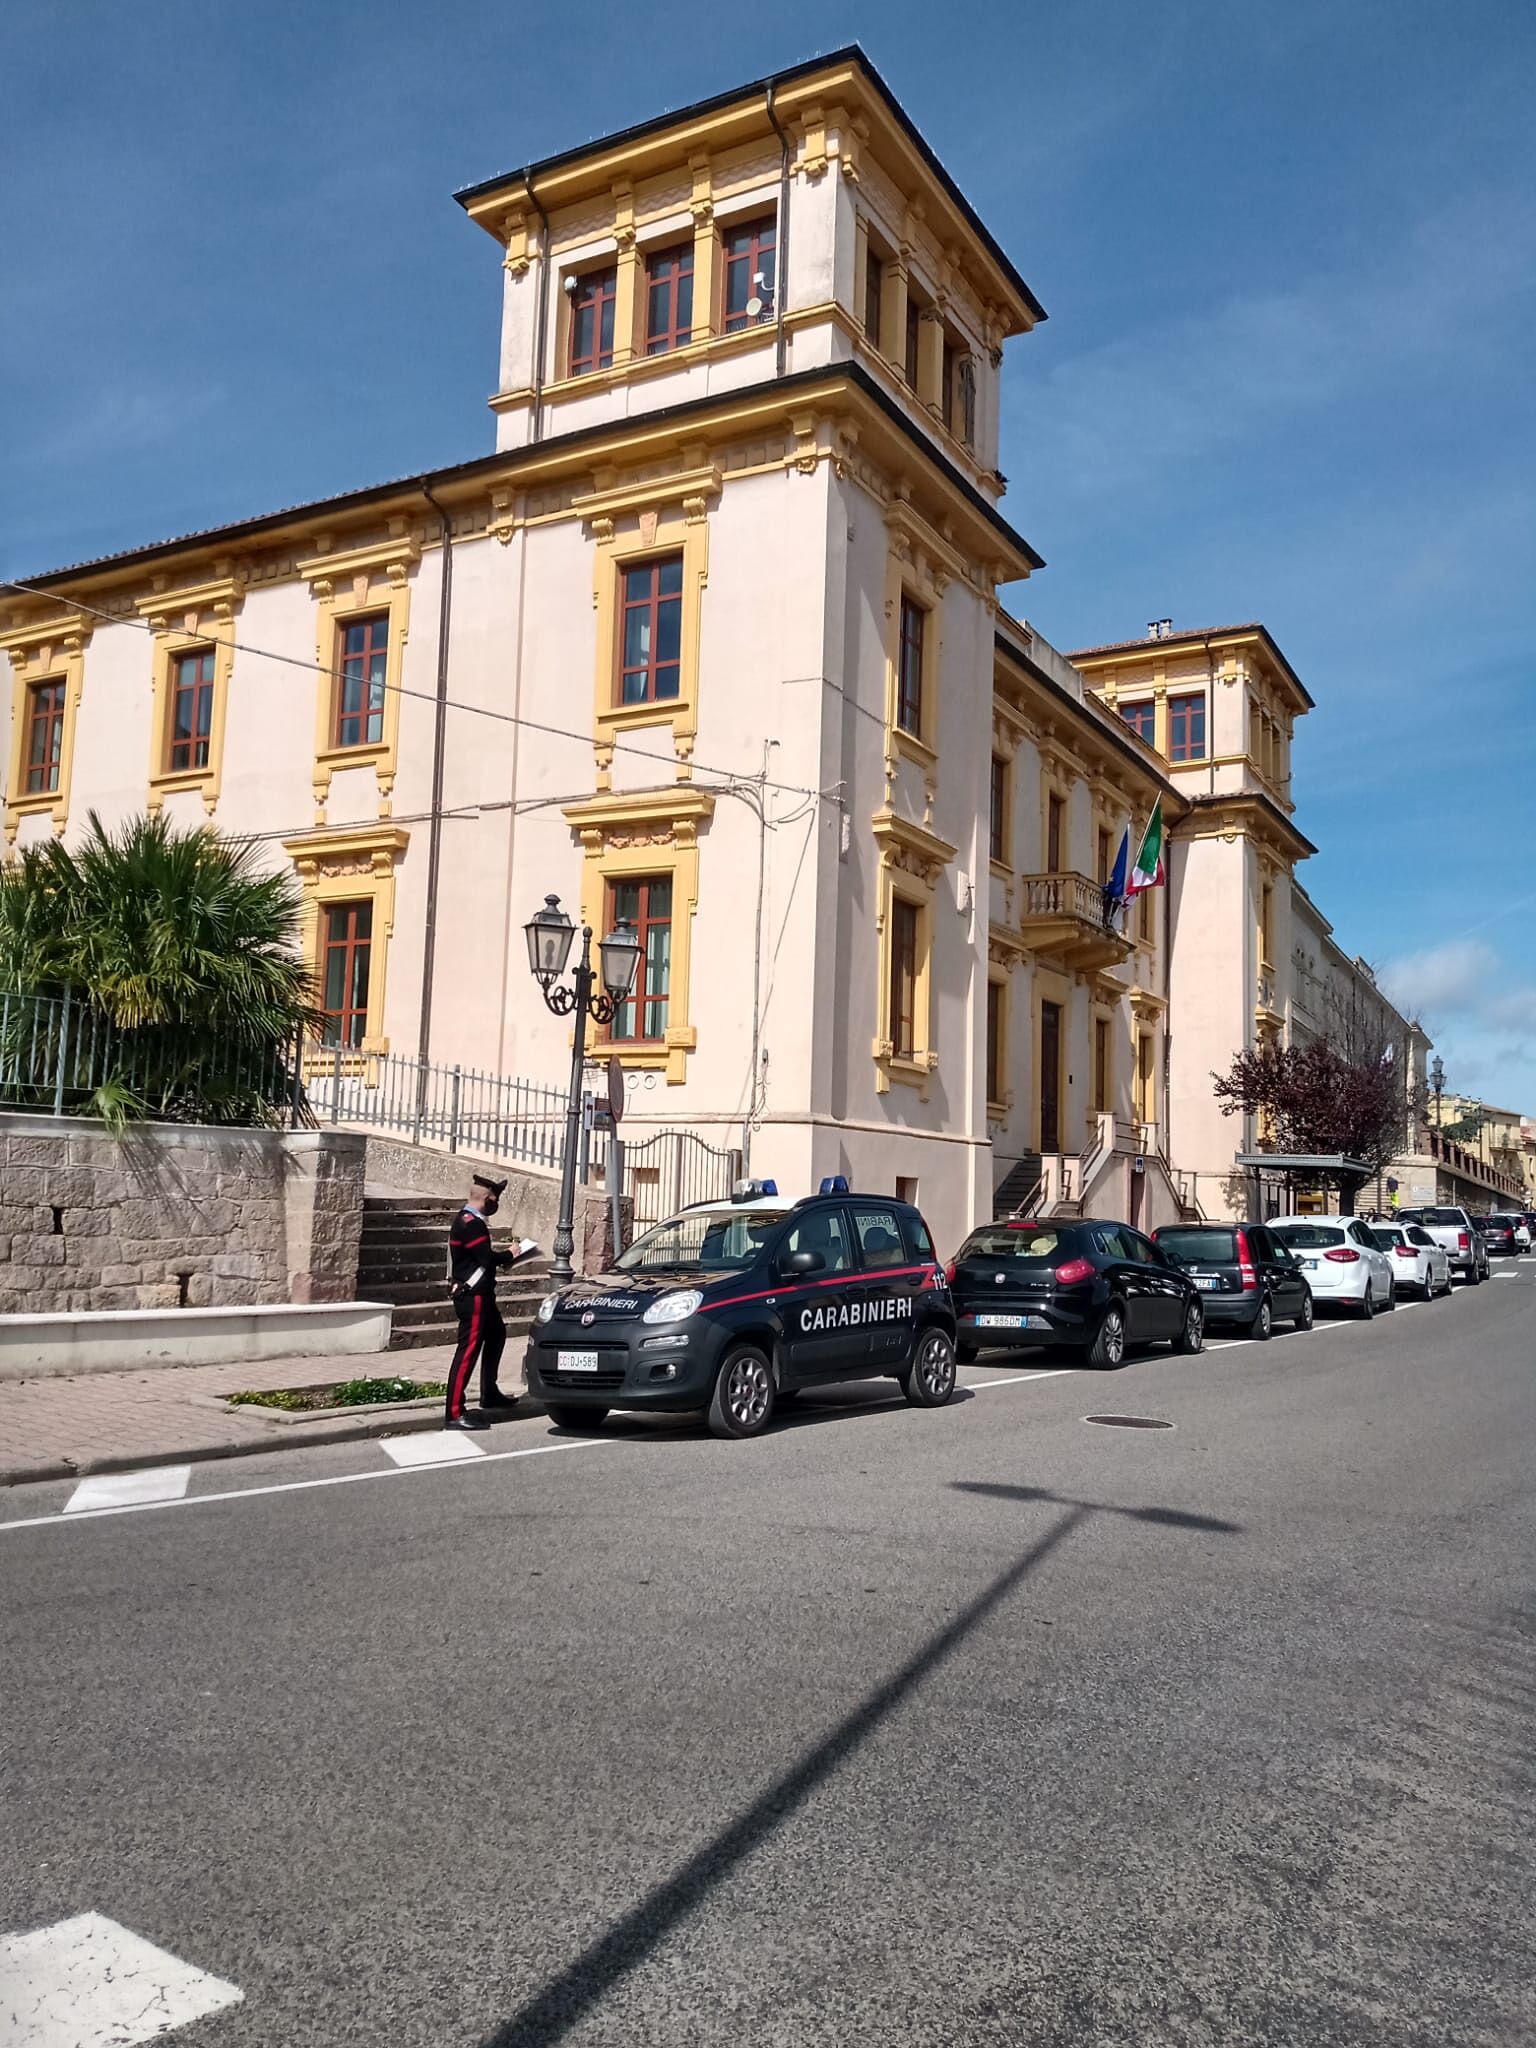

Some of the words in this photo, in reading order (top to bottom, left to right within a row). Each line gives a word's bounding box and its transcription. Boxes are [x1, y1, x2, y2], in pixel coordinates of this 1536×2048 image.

[932, 1272, 948, 1291] 112
[564, 1297, 638, 1310] CARABINIERI
[800, 1297, 912, 1332] CARABINIERI
